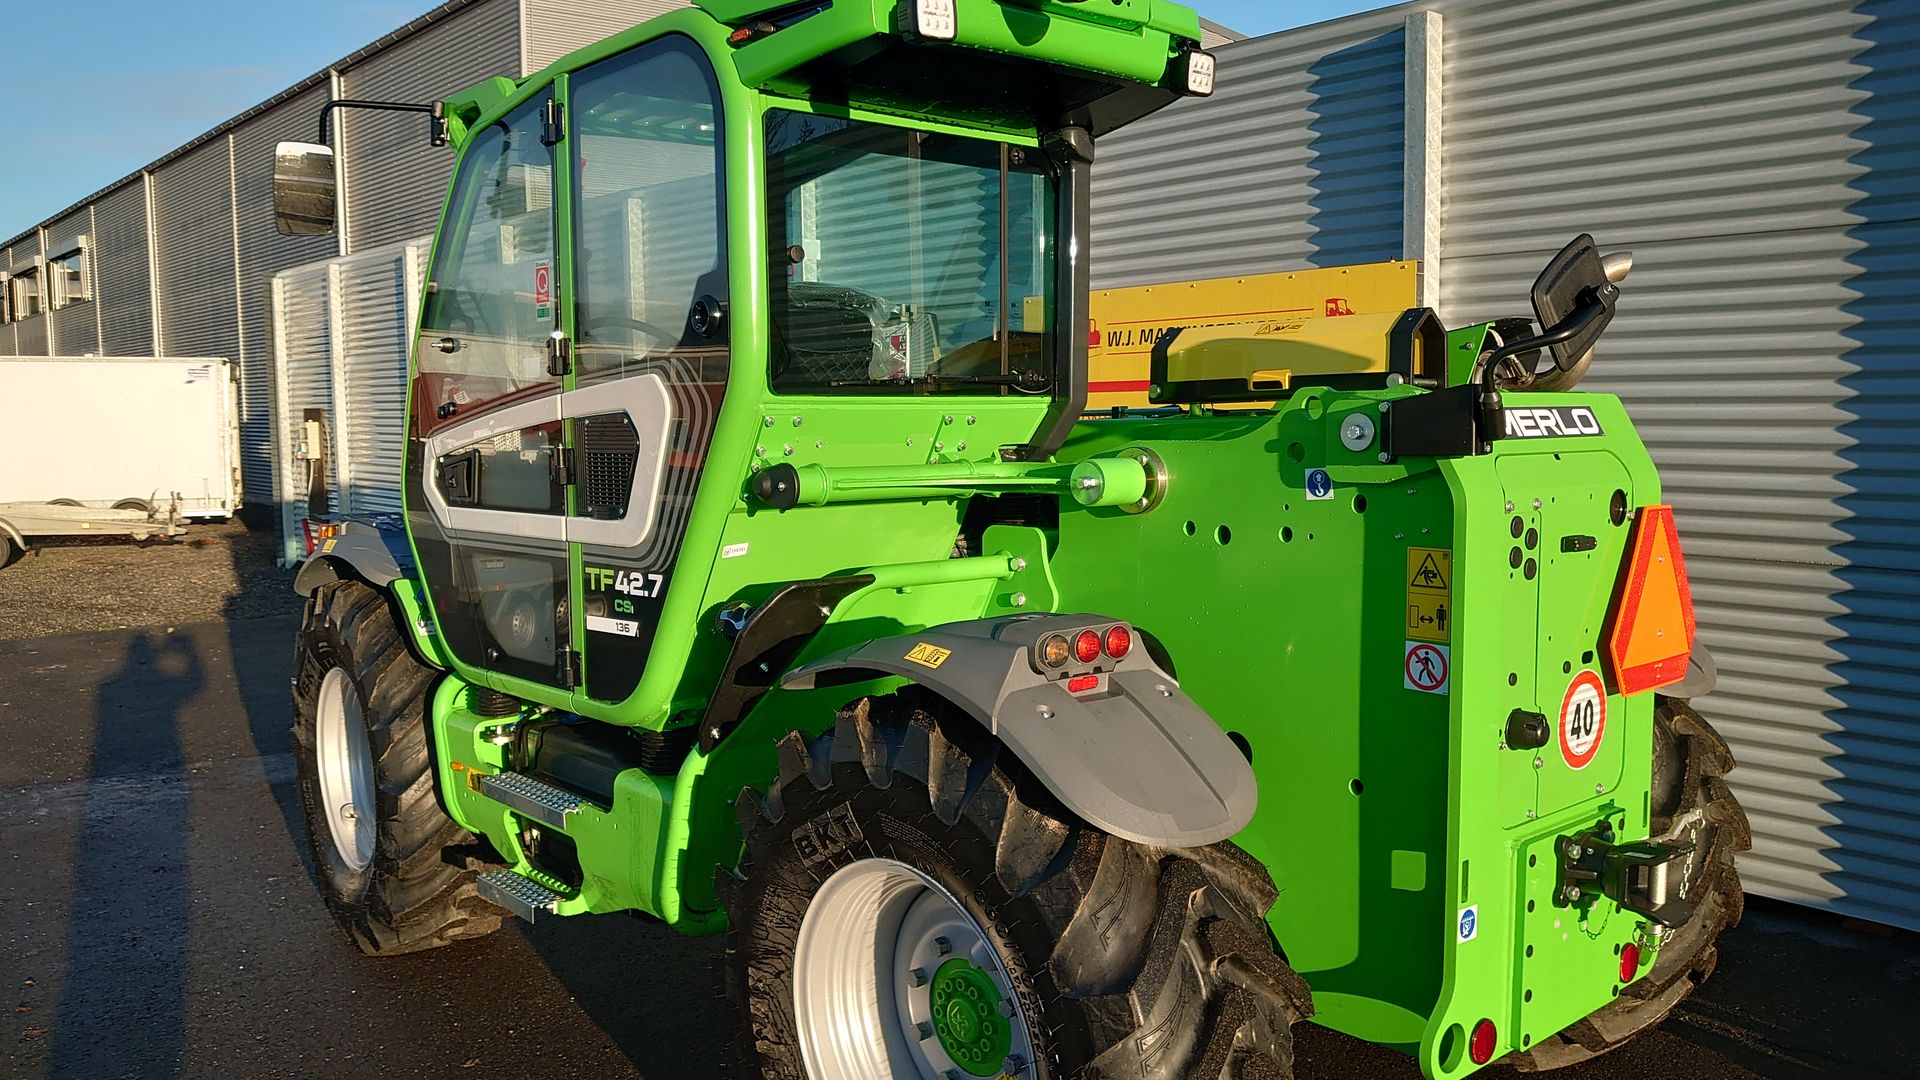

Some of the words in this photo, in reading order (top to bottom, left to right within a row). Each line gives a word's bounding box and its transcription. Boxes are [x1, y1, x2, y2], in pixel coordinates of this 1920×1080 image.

[1107, 330, 1134, 347] W.J.
[615, 622, 630, 633] 136
[1570, 699, 1594, 740] 40
[794, 807, 861, 861] BKT
